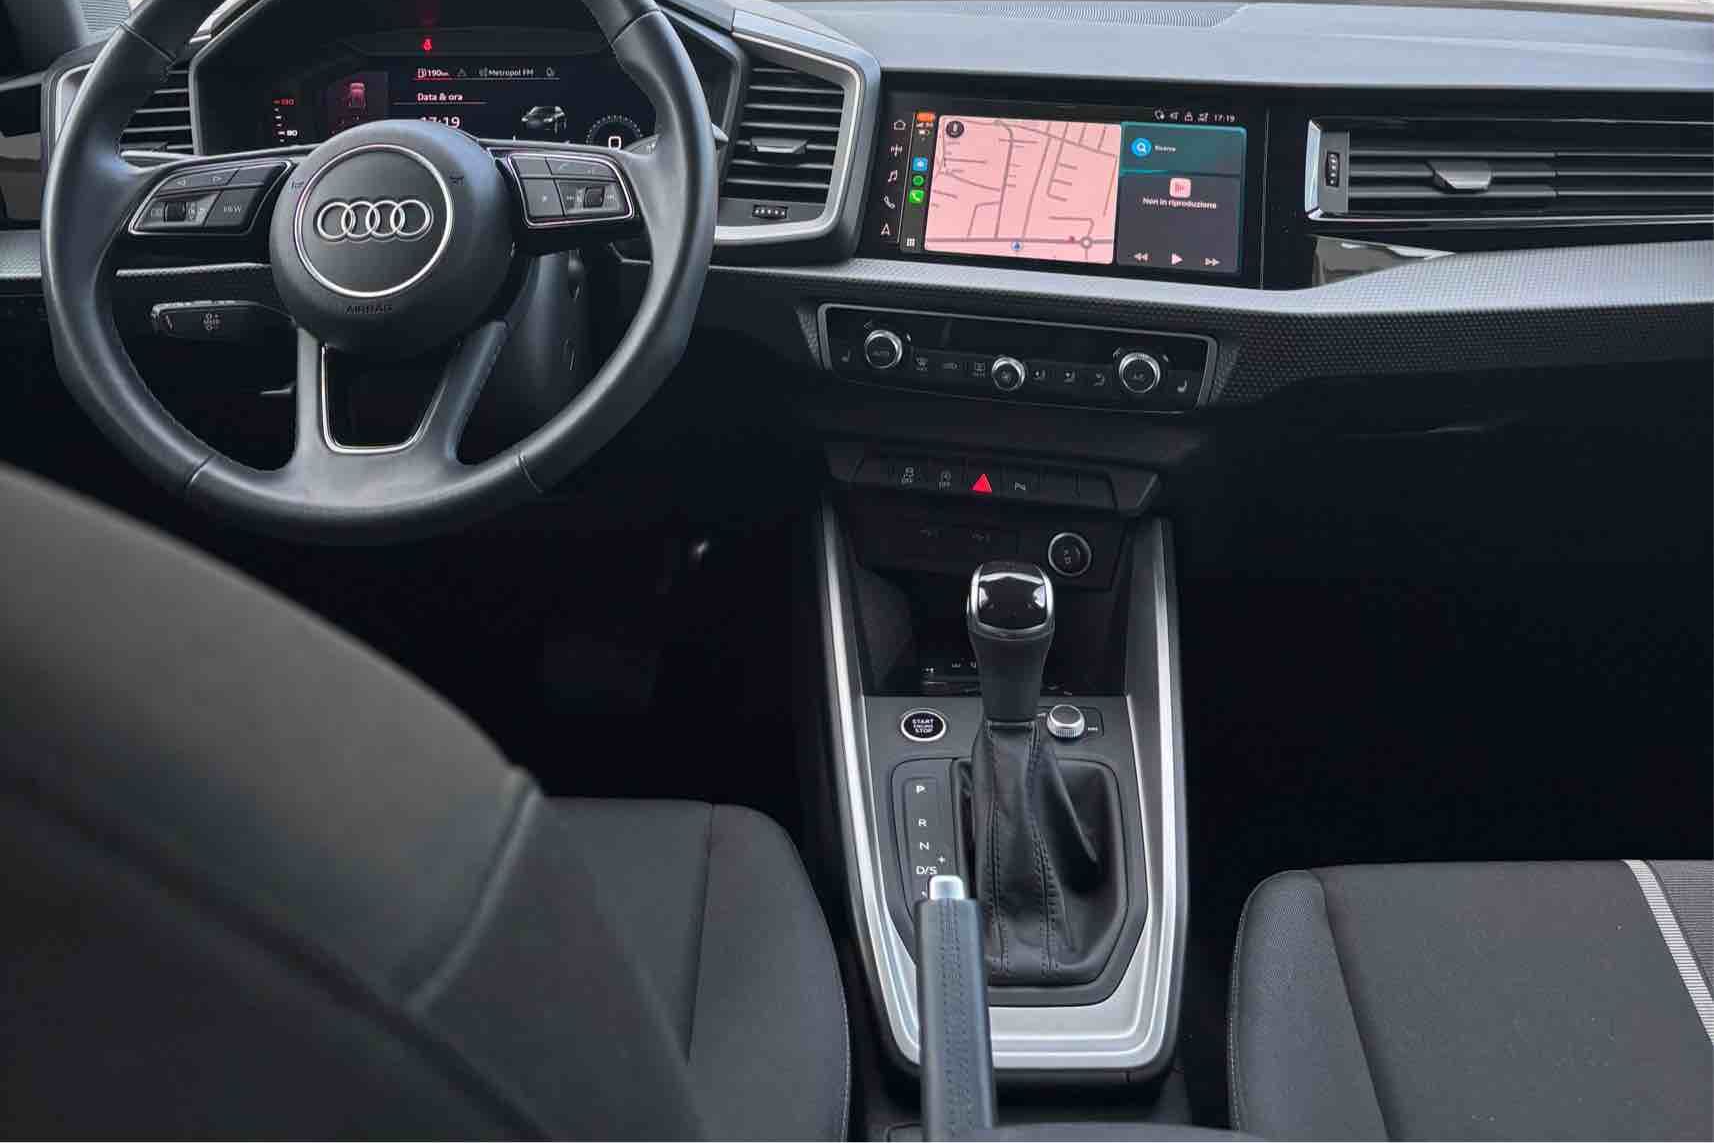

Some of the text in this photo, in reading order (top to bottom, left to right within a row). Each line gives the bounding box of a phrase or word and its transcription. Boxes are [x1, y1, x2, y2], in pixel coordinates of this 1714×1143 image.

[488, 68, 534, 78] Metropol FM
[417, 92, 438, 101] Data
[439, 93, 447, 101] &
[1142, 197, 1159, 206] Non
[1168, 200, 1217, 209] riproduzione
[916, 785, 925, 793] P
[918, 819, 928, 827] R
[919, 842, 930, 850] N
[916, 865, 937, 875] D/S
